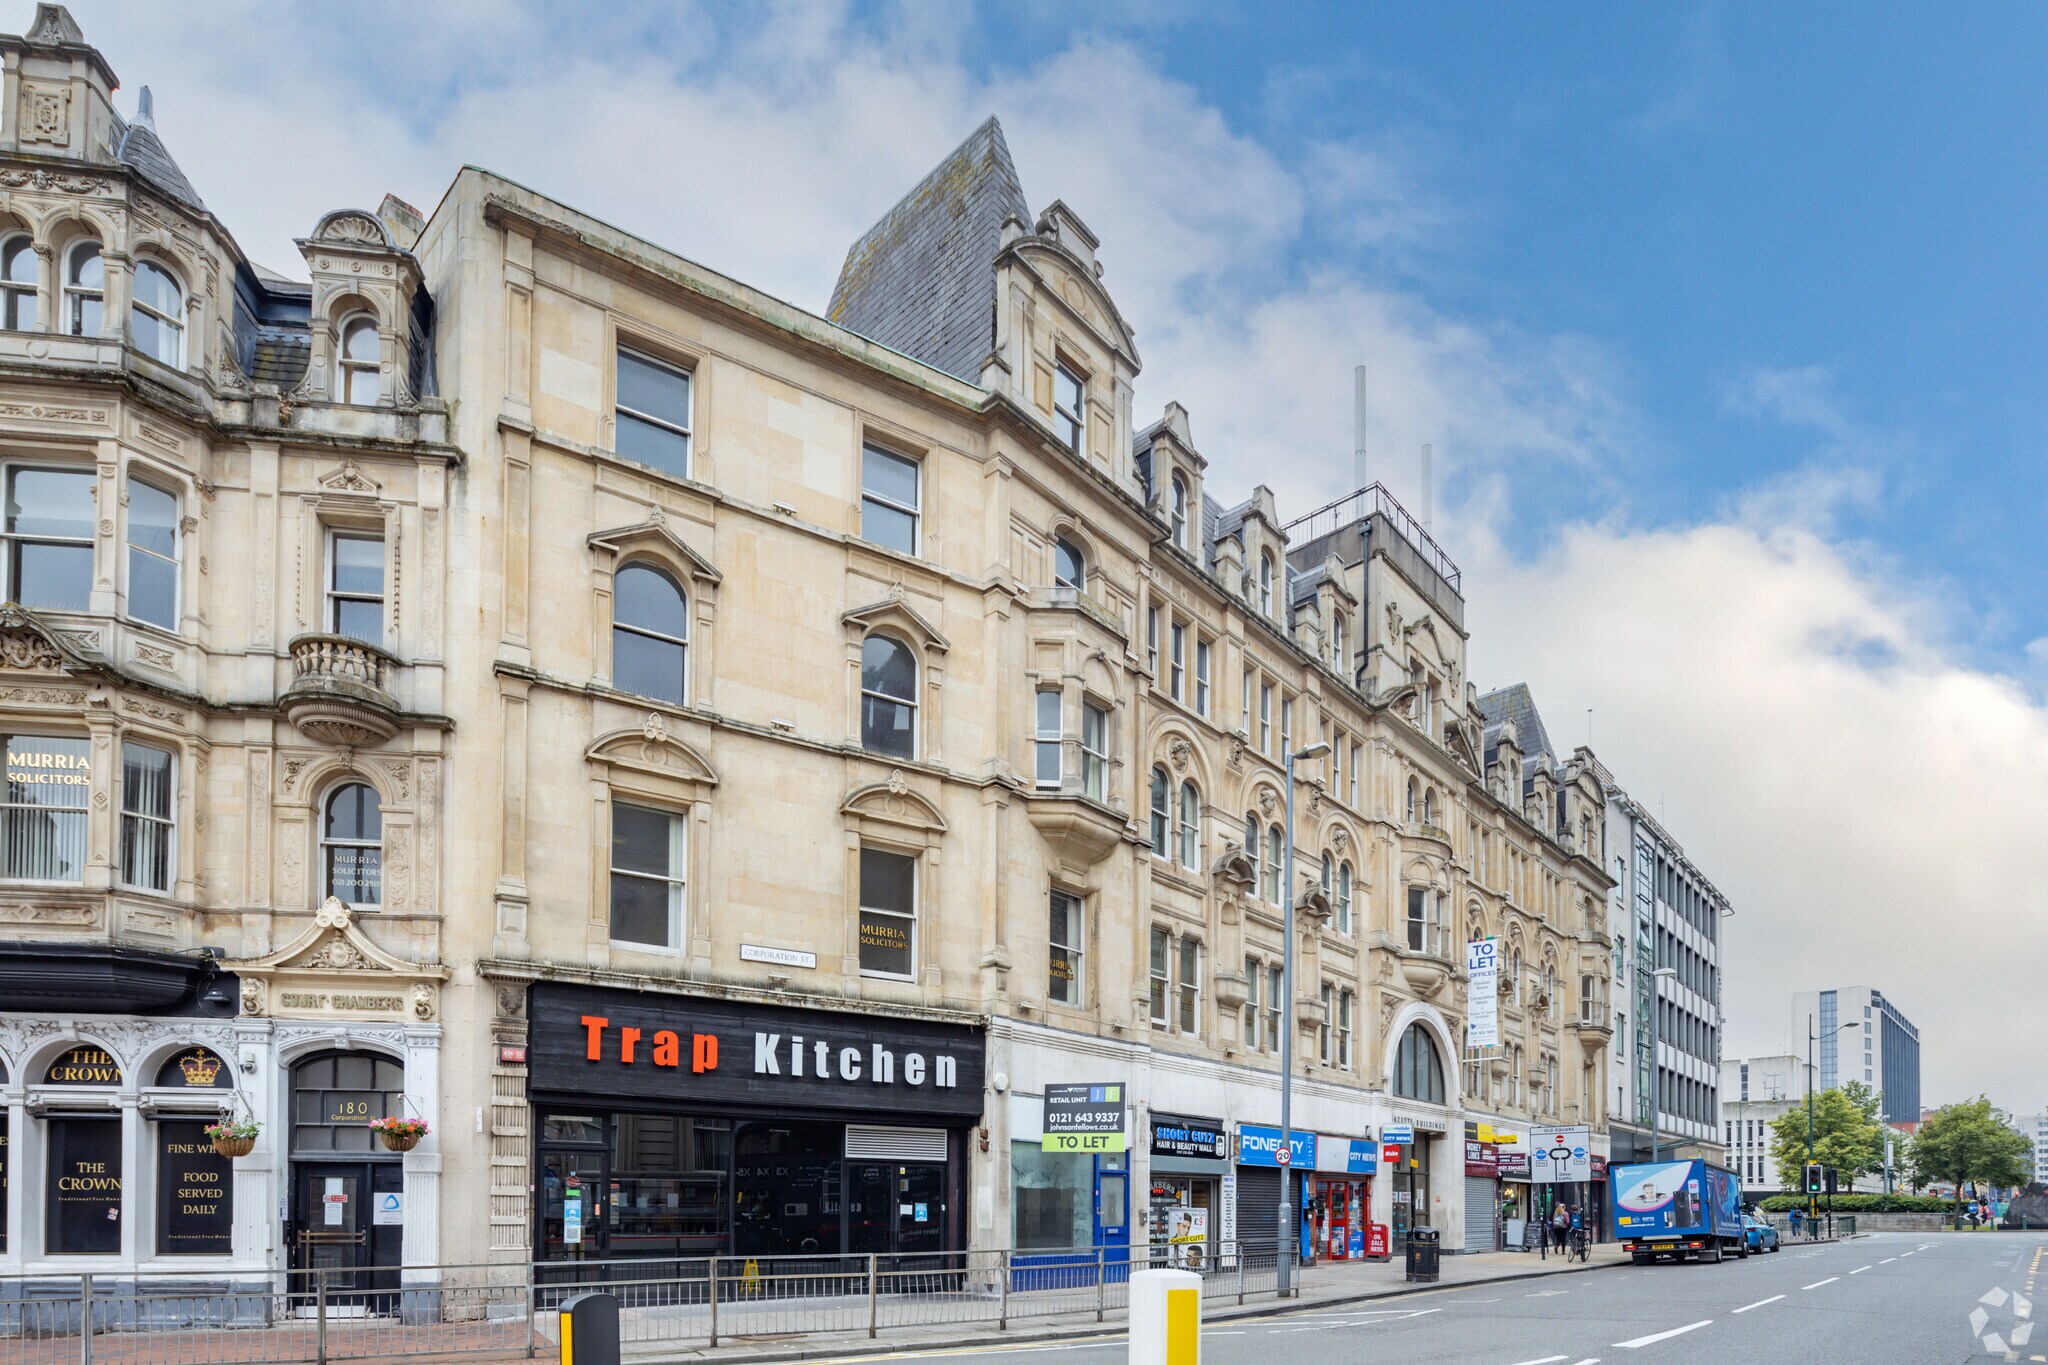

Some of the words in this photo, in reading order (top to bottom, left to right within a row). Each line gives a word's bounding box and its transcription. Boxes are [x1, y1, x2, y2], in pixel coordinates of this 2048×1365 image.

[8, 752, 91, 770] MURRIA
[8, 772, 90, 786] SOLICITORS
[334, 855, 378, 865] MURRIA
[332, 867, 381, 876] SOLICITORS
[862, 924, 906, 940] MURRIA
[860, 936, 908, 950] SOLICITORS
[1472, 944, 1493, 956] TO
[744, 949, 798, 962] CORPORATION
[800, 956, 809, 964] ST
[1050, 958, 1072, 972] URRIA
[1470, 956, 1496, 970] LET
[1470, 970, 1496, 978] OFFICES
[281, 992, 327, 1008] COURT
[331, 995, 404, 1010] CHAMBERS
[69, 1050, 112, 1064] THE
[581, 1015, 719, 1074] Trap
[754, 1031, 957, 1088] Kitchen
[340, 1102, 368, 1114] 180
[1050, 1113, 1072, 1122] 0121
[1075, 1112, 1092, 1122] 643
[1095, 1112, 1120, 1122] 9337
[1050, 1124, 1118, 1132] johnsonfellows.co.uk
[1416, 1120, 1446, 1130] BUILDINGS
[1156, 1126, 1190, 1140] SHORT
[1192, 1130, 1216, 1144] CUTZ
[1057, 1136, 1078, 1148] TO
[1084, 1136, 1110, 1148] LET
[1156, 1140, 1170, 1148] HAIR
[1172, 1142, 1176, 1150] &
[1176, 1142, 1198, 1151] BEAUTY
[168, 1144, 194, 1154] FINE
[1278, 1152, 1289, 1160] 20
[1350, 1152, 1362, 1162] CITY
[1362, 1152, 1376, 1162] NEWS
[76, 1162, 105, 1173] THE
[184, 1172, 218, 1182] FOOD
[58, 1177, 122, 1190] CROWN
[178, 1188, 223, 1198] SERVED
[183, 1205, 217, 1214] DAILY
